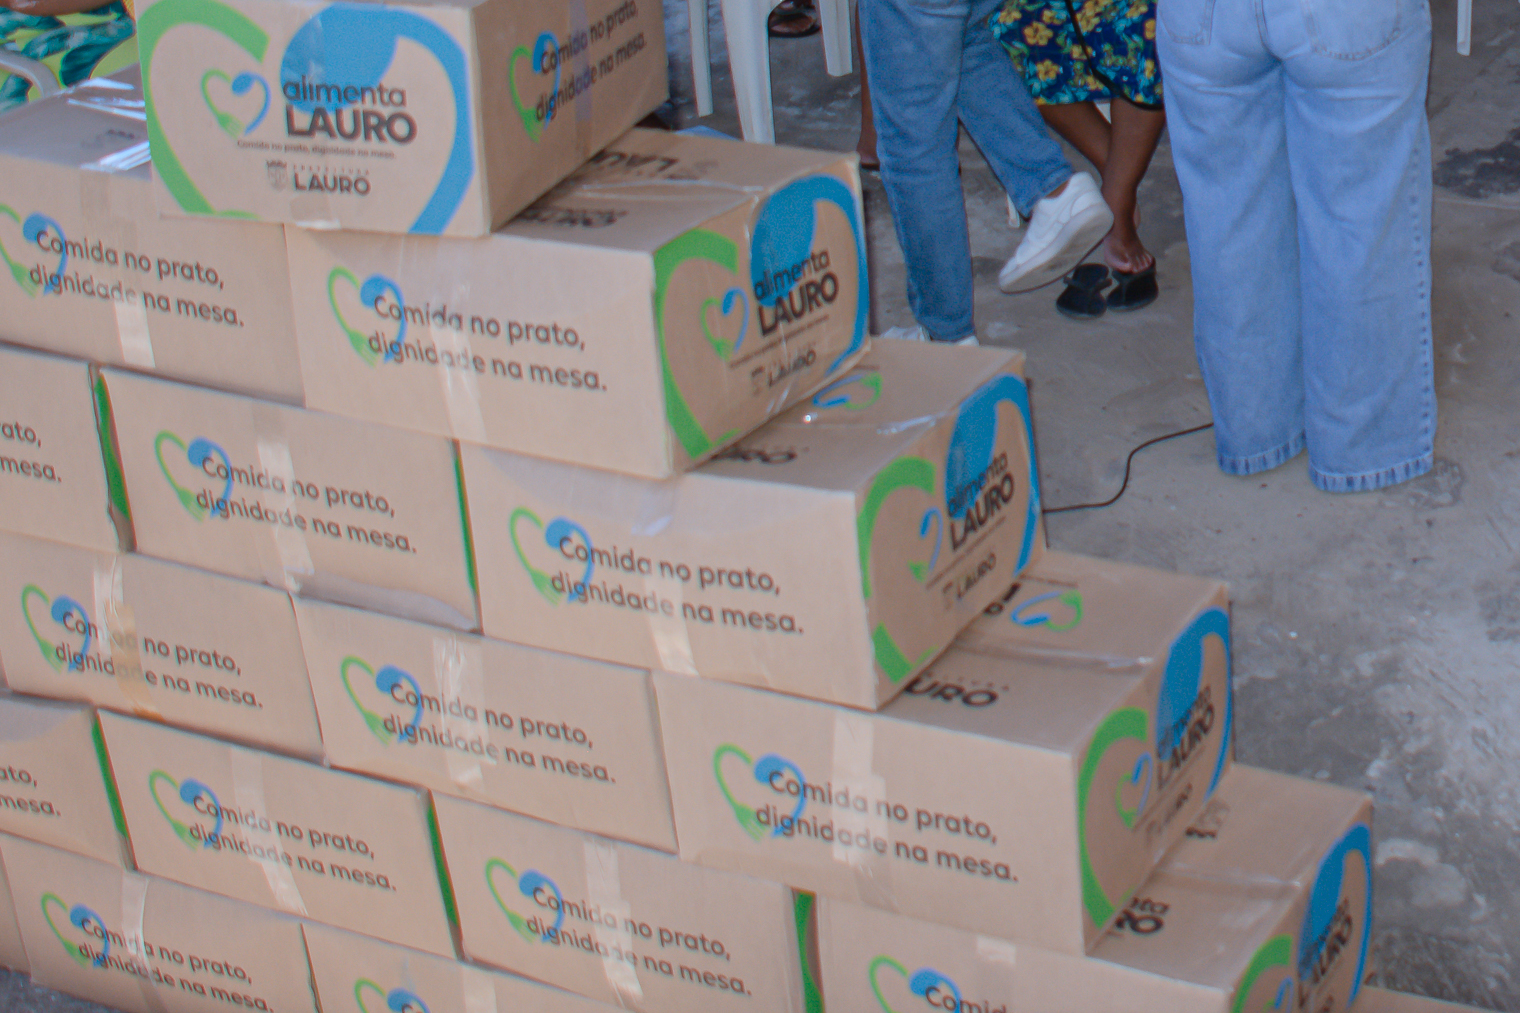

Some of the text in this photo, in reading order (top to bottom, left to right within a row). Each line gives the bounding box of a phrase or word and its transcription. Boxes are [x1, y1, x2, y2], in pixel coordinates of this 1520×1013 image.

[541, 29, 588, 75] Comida
[590, 21, 605, 44] no
[283, 75, 407, 107] alimenta
[536, 65, 598, 121] dignidade
[599, 53, 614, 79] na
[287, 104, 418, 145] LAURO
[294, 173, 372, 196] LAURO
[37, 230, 224, 290] Comida no prato,
[754, 249, 830, 301] alimenta
[30, 263, 244, 327] dignidade na mesa.
[374, 295, 586, 352] Comida no prato,
[758, 271, 839, 336] LAURO
[368, 331, 607, 392] dignidade na mesa.
[0, 421, 41, 448] ato,
[0, 456, 62, 482] mesa.
[202, 456, 395, 518] Comida no prato,
[196, 488, 417, 553] dignidade na mesa.
[950, 471, 1015, 551] LAURO
[559, 536, 780, 596] Comida no prato,
[551, 570, 804, 634] dignidade na mesa.
[144, 636, 170, 657] no
[175, 644, 241, 676] prato,
[162, 673, 191, 693] na
[196, 680, 263, 709] mesa.
[390, 683, 593, 749] Comida no prato,
[383, 714, 616, 783] dignidade na mesa.
[0, 794, 61, 817] mesa.
[193, 795, 375, 860] Comida no prato,
[769, 770, 998, 845] Comida no prato,
[189, 823, 396, 891] dignidade na mesa.
[756, 804, 1018, 882] dignidade na mesa.
[532, 887, 731, 961] Comida no prato,
[158, 945, 185, 965] no
[189, 954, 252, 985] prato,
[179, 977, 207, 997] na
[211, 986, 274, 1013] mesa.
[643, 954, 674, 976] na
[679, 964, 752, 996] mesa.
